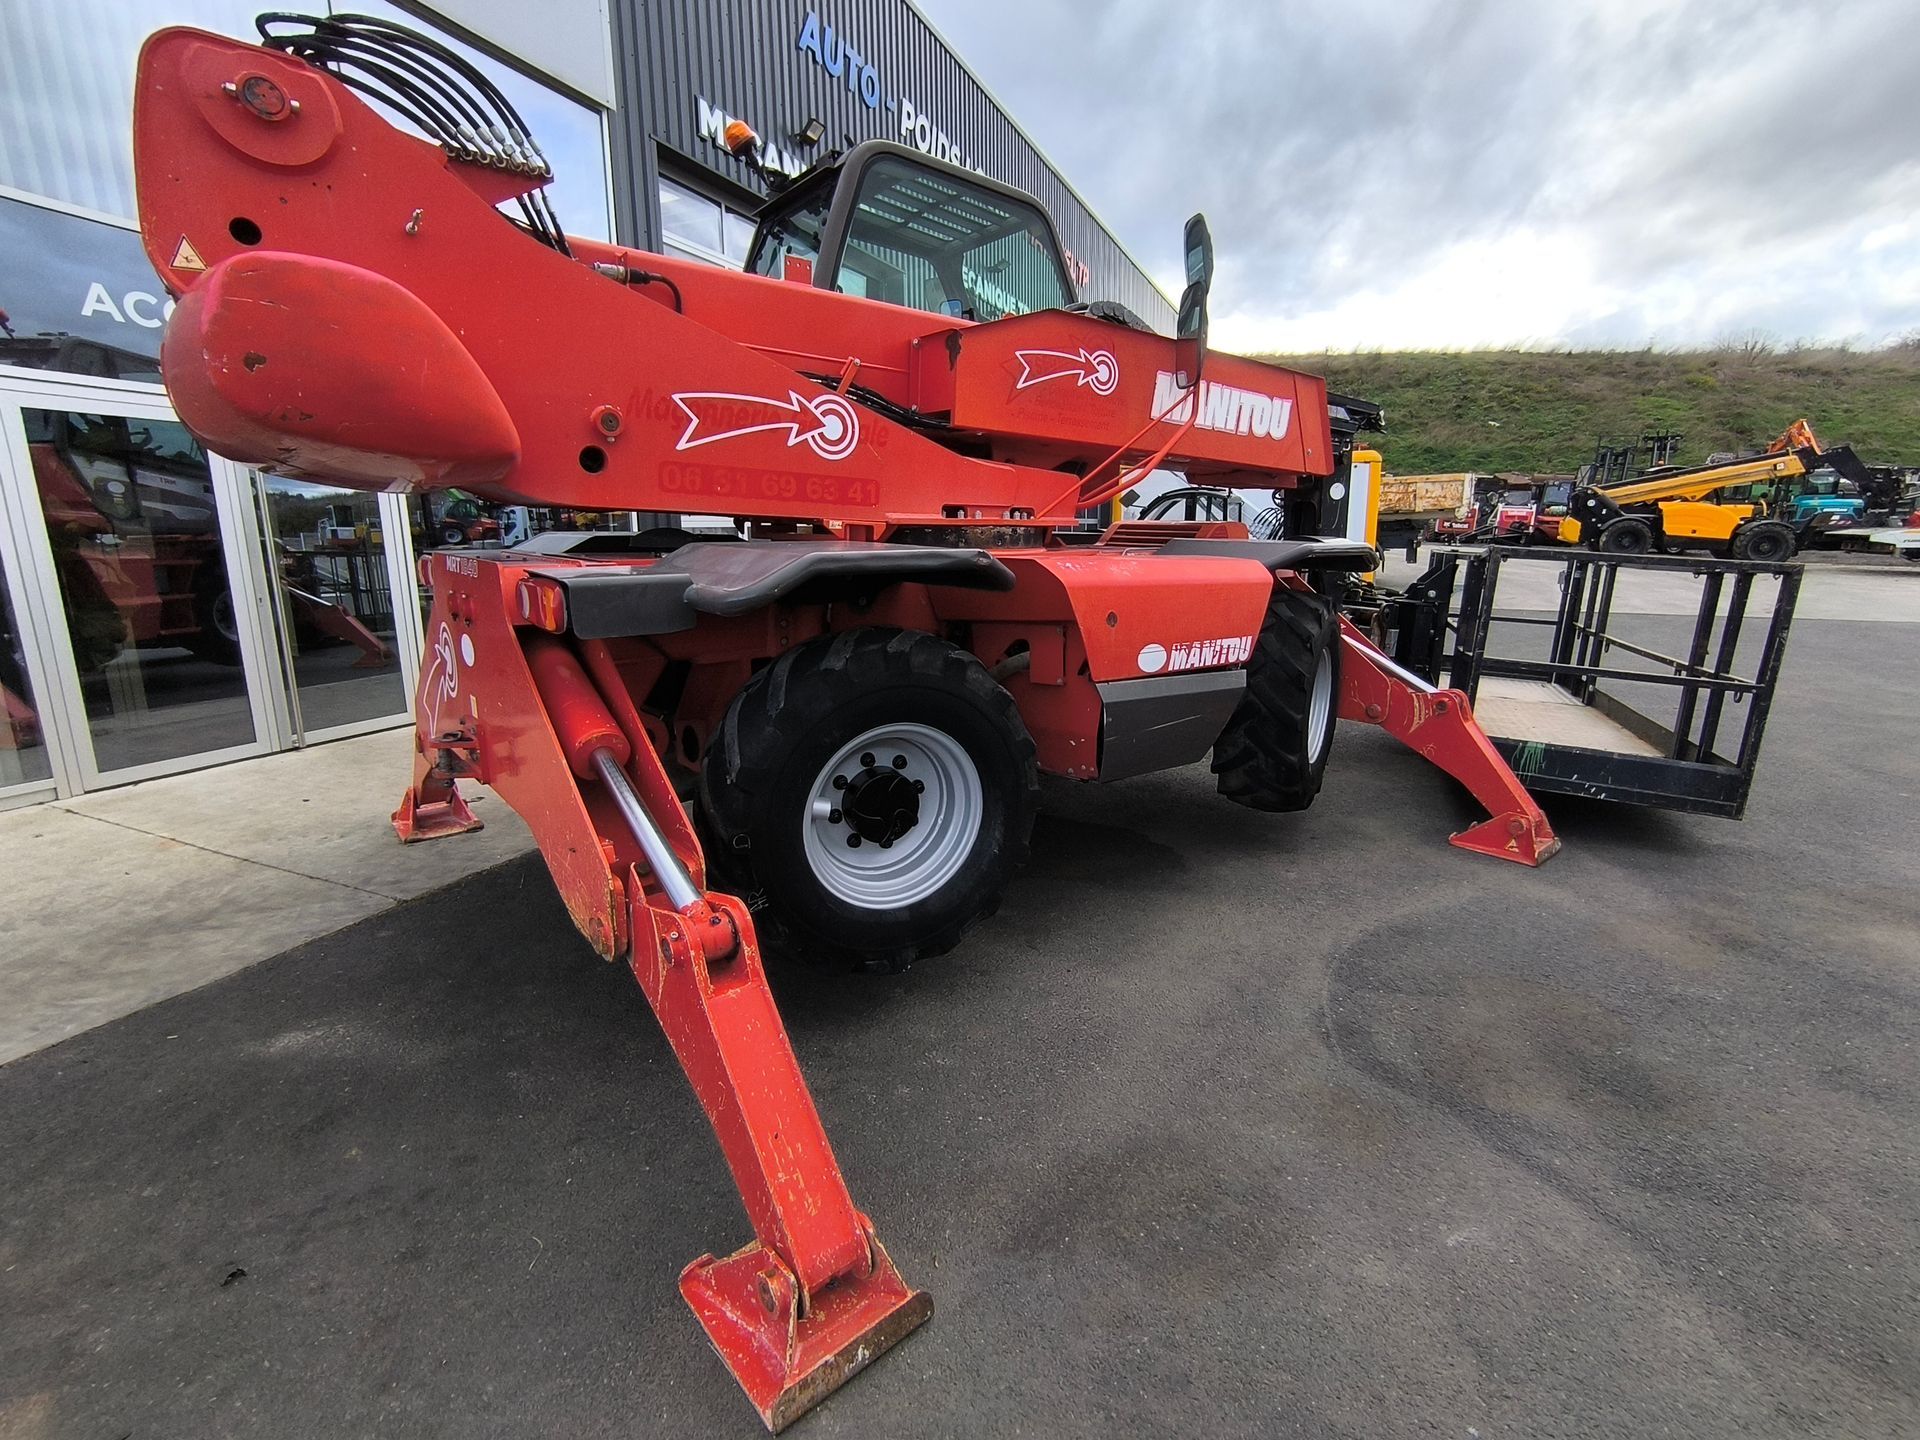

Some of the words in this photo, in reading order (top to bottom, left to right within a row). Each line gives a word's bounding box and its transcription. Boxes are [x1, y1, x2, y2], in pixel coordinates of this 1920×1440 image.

[799, 11, 880, 109] AUTO
[901, 98, 962, 165] POIDS
[81, 282, 176, 328] AC
[1150, 370, 1293, 440] MANITOU
[761, 473, 798, 498] 69
[847, 480, 879, 504] 41
[1168, 636, 1252, 671] MANITOU
